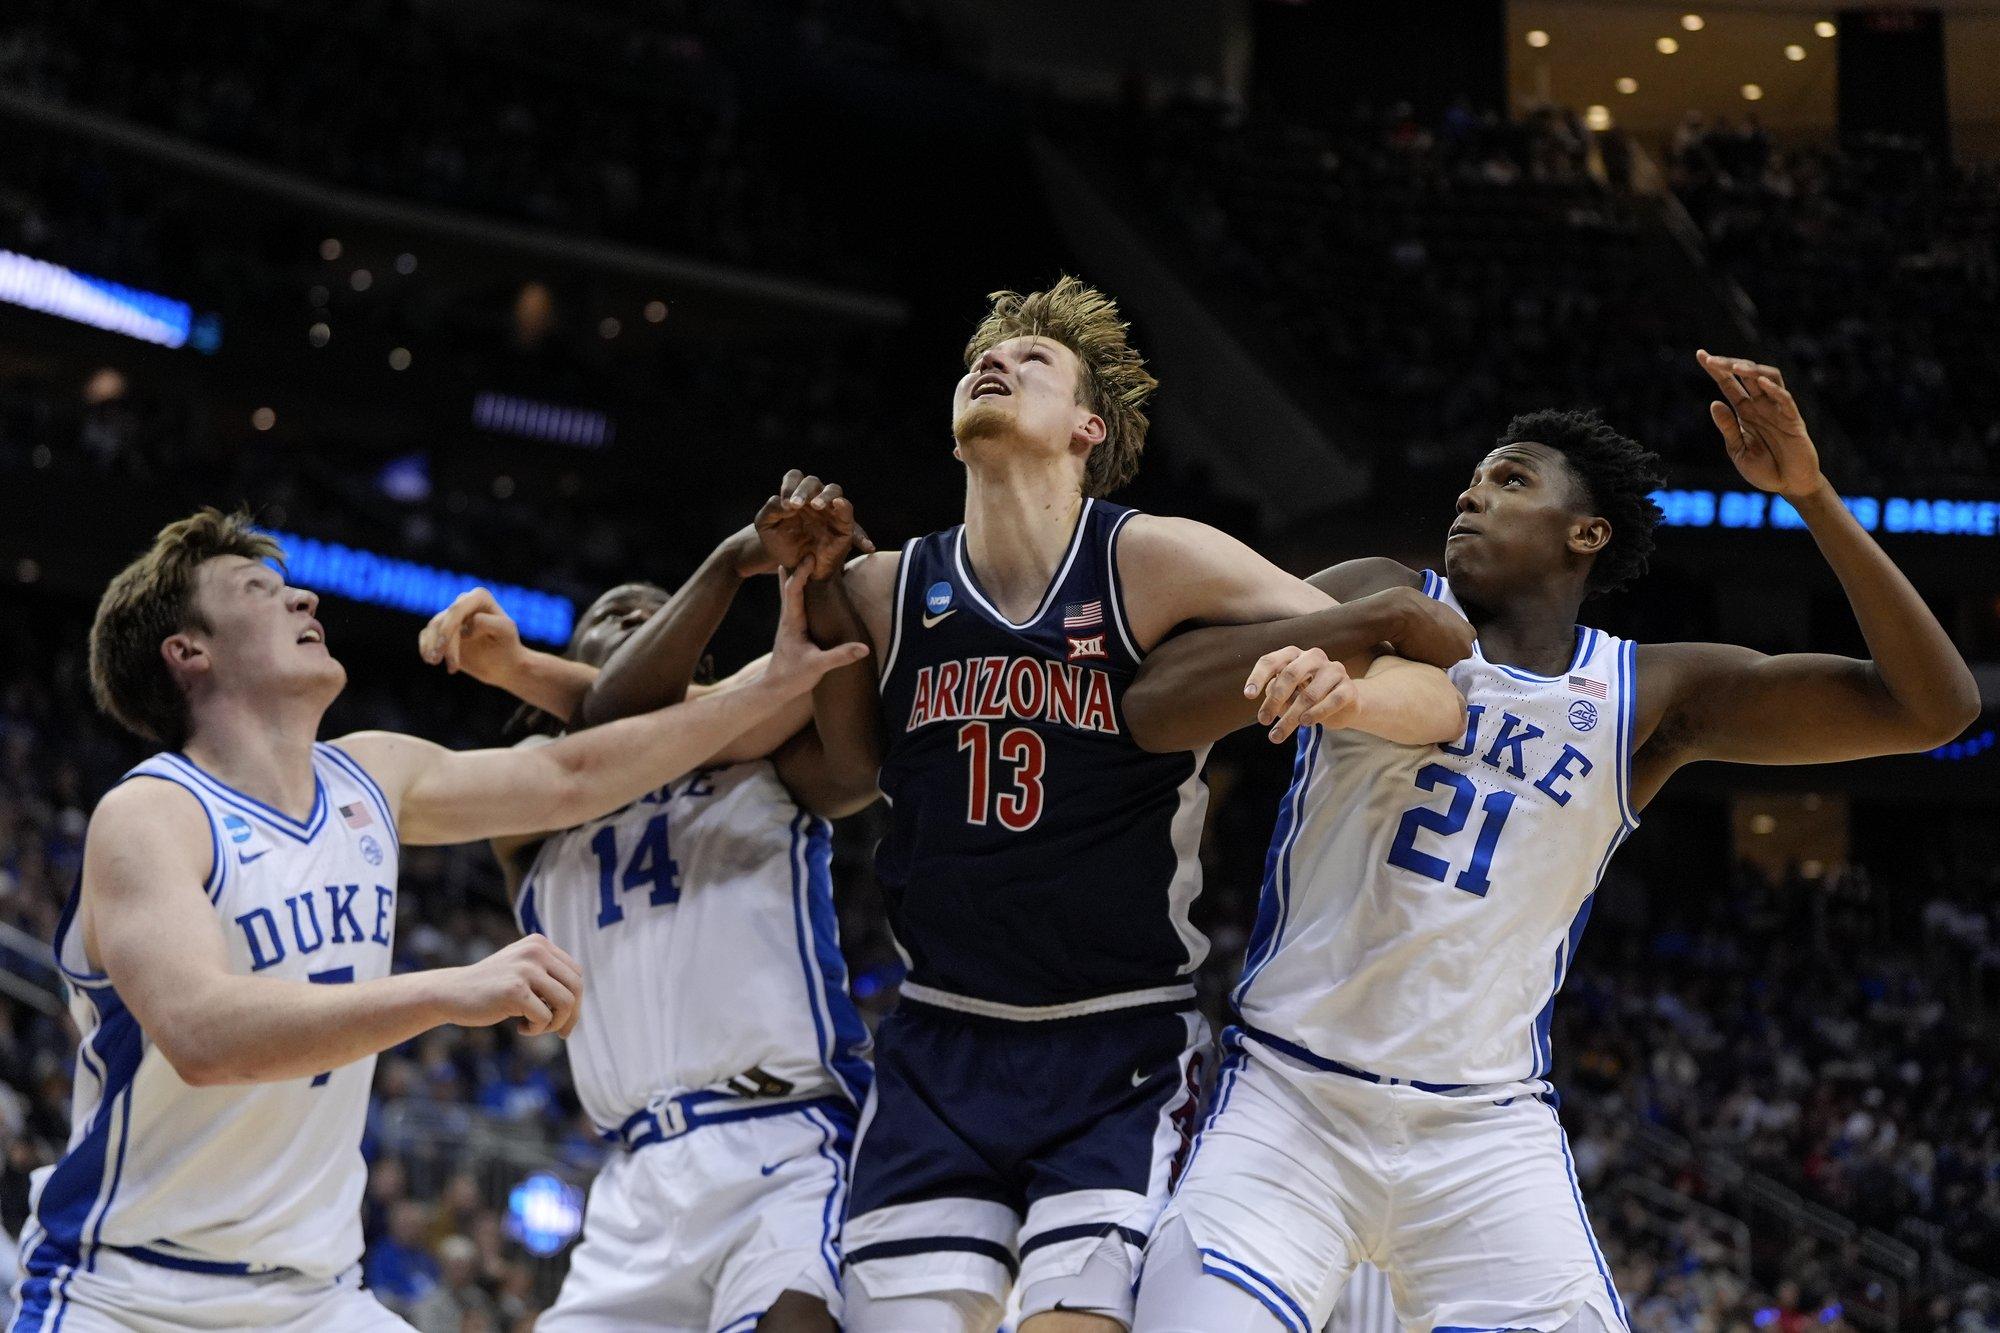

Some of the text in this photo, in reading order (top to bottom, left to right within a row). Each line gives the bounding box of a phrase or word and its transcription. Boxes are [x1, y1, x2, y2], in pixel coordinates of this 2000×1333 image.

[1883, 496, 1999, 536] BASKE
[906, 656, 1120, 735] ARIZONA
[1572, 709, 1597, 722] ACC
[958, 720, 1046, 832] 13
[1437, 704, 1594, 808] UKE
[591, 813, 682, 930] 14
[1387, 762, 1518, 898] 21
[234, 884, 393, 972] DUKE
